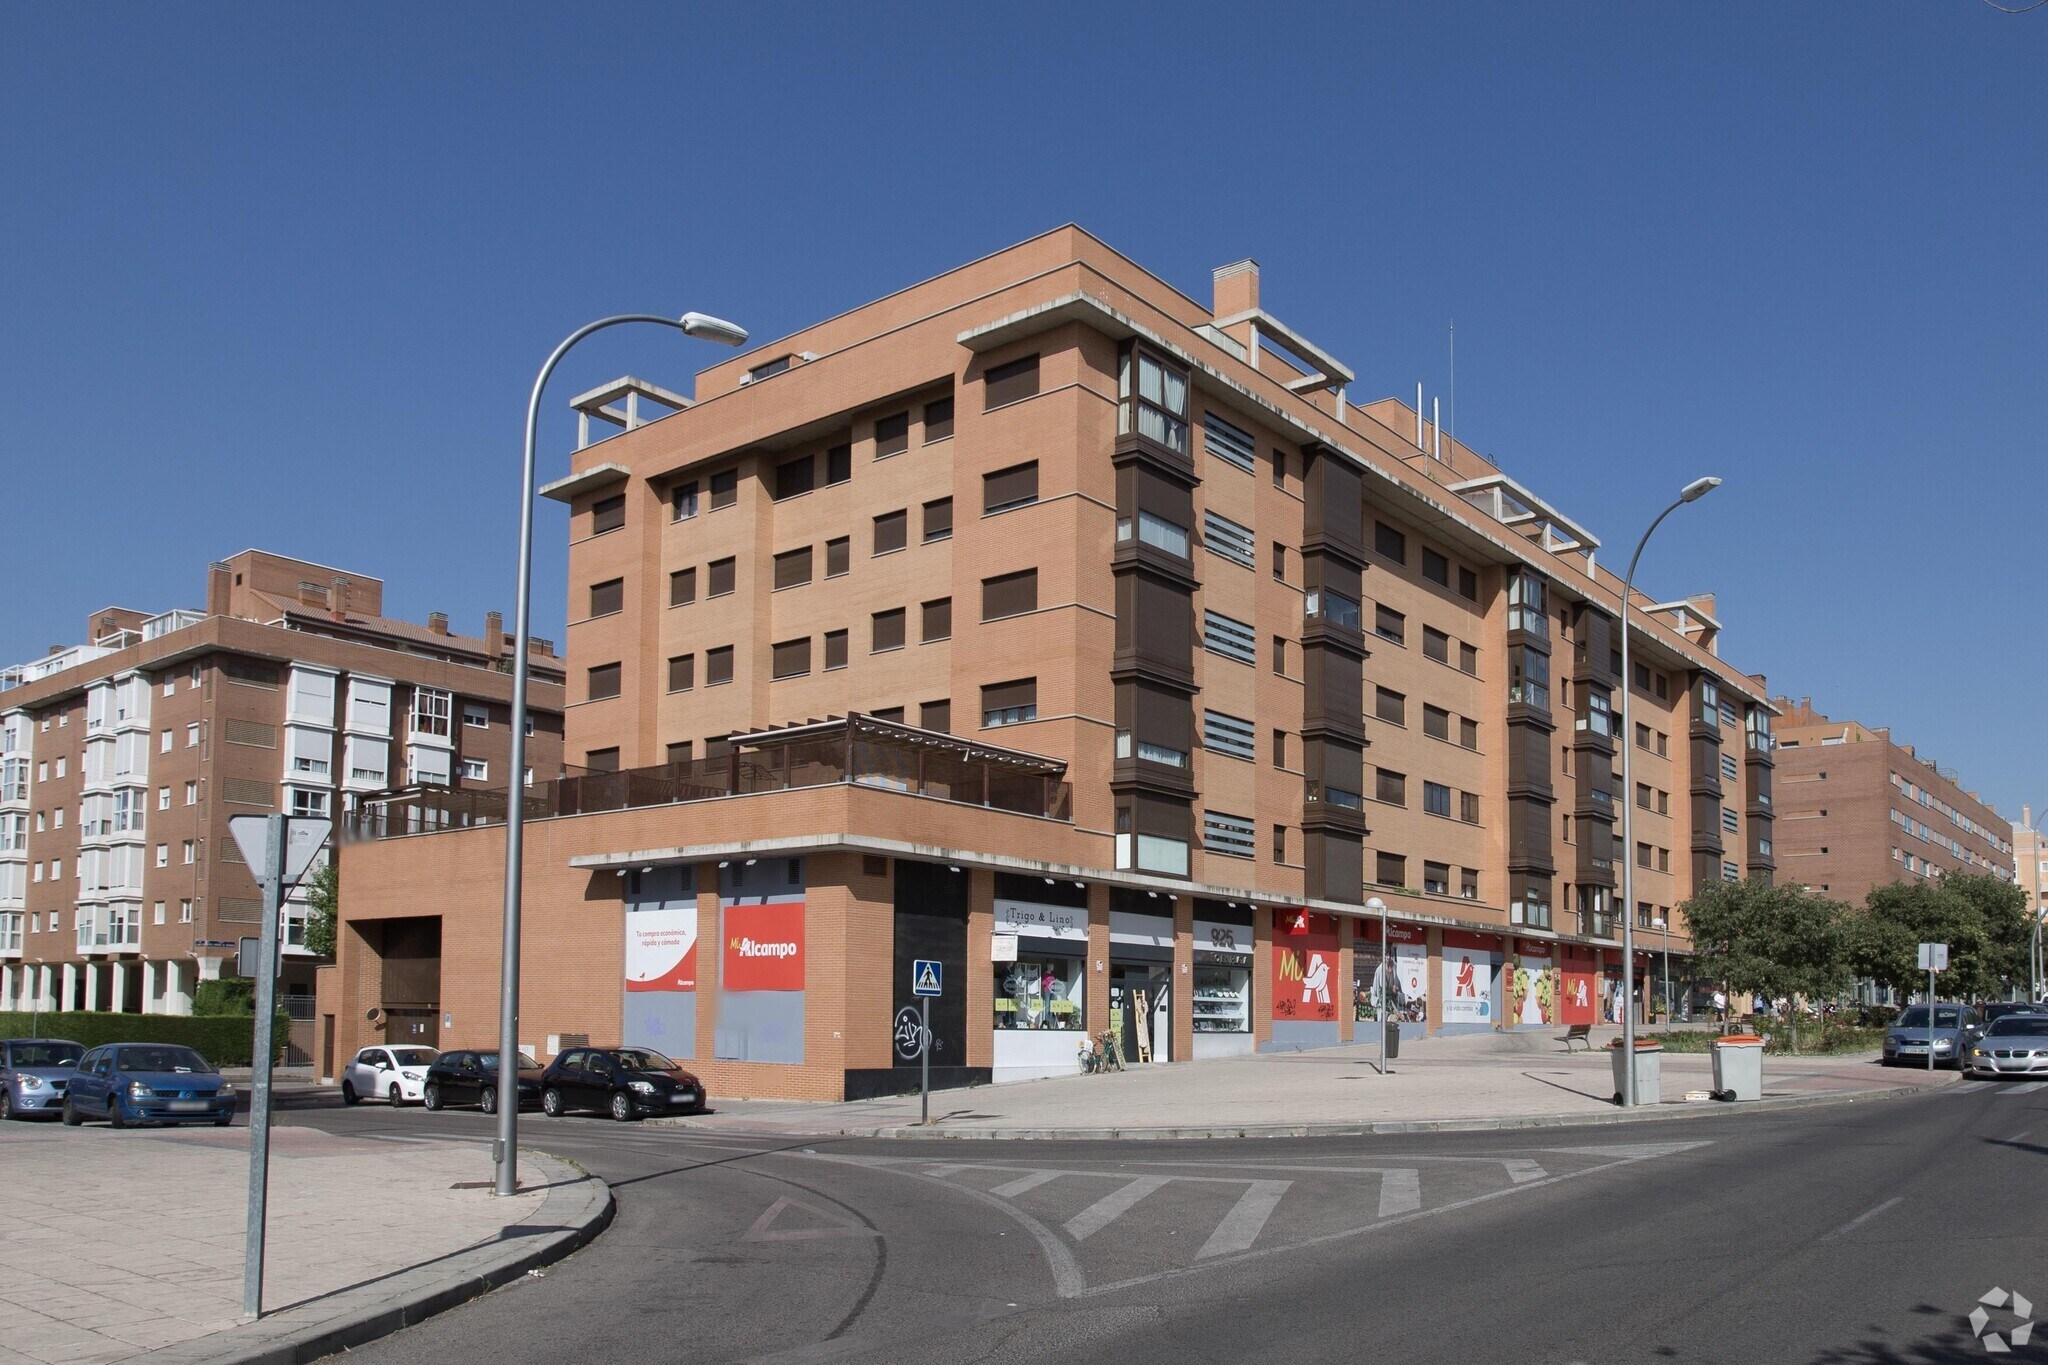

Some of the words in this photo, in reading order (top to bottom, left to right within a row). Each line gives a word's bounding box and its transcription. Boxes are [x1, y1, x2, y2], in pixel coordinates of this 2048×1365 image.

[1010, 907, 1035, 924] Trigo
[1038, 912, 1045, 922] &
[1049, 911, 1070, 924] Lino
[642, 930, 660, 938] compra
[1211, 928, 1234, 947] 925
[730, 937, 741, 949] Mi
[739, 937, 797, 959] Alcampo
[1279, 950, 1304, 982] Mi
[1566, 978, 1578, 995] Mi
